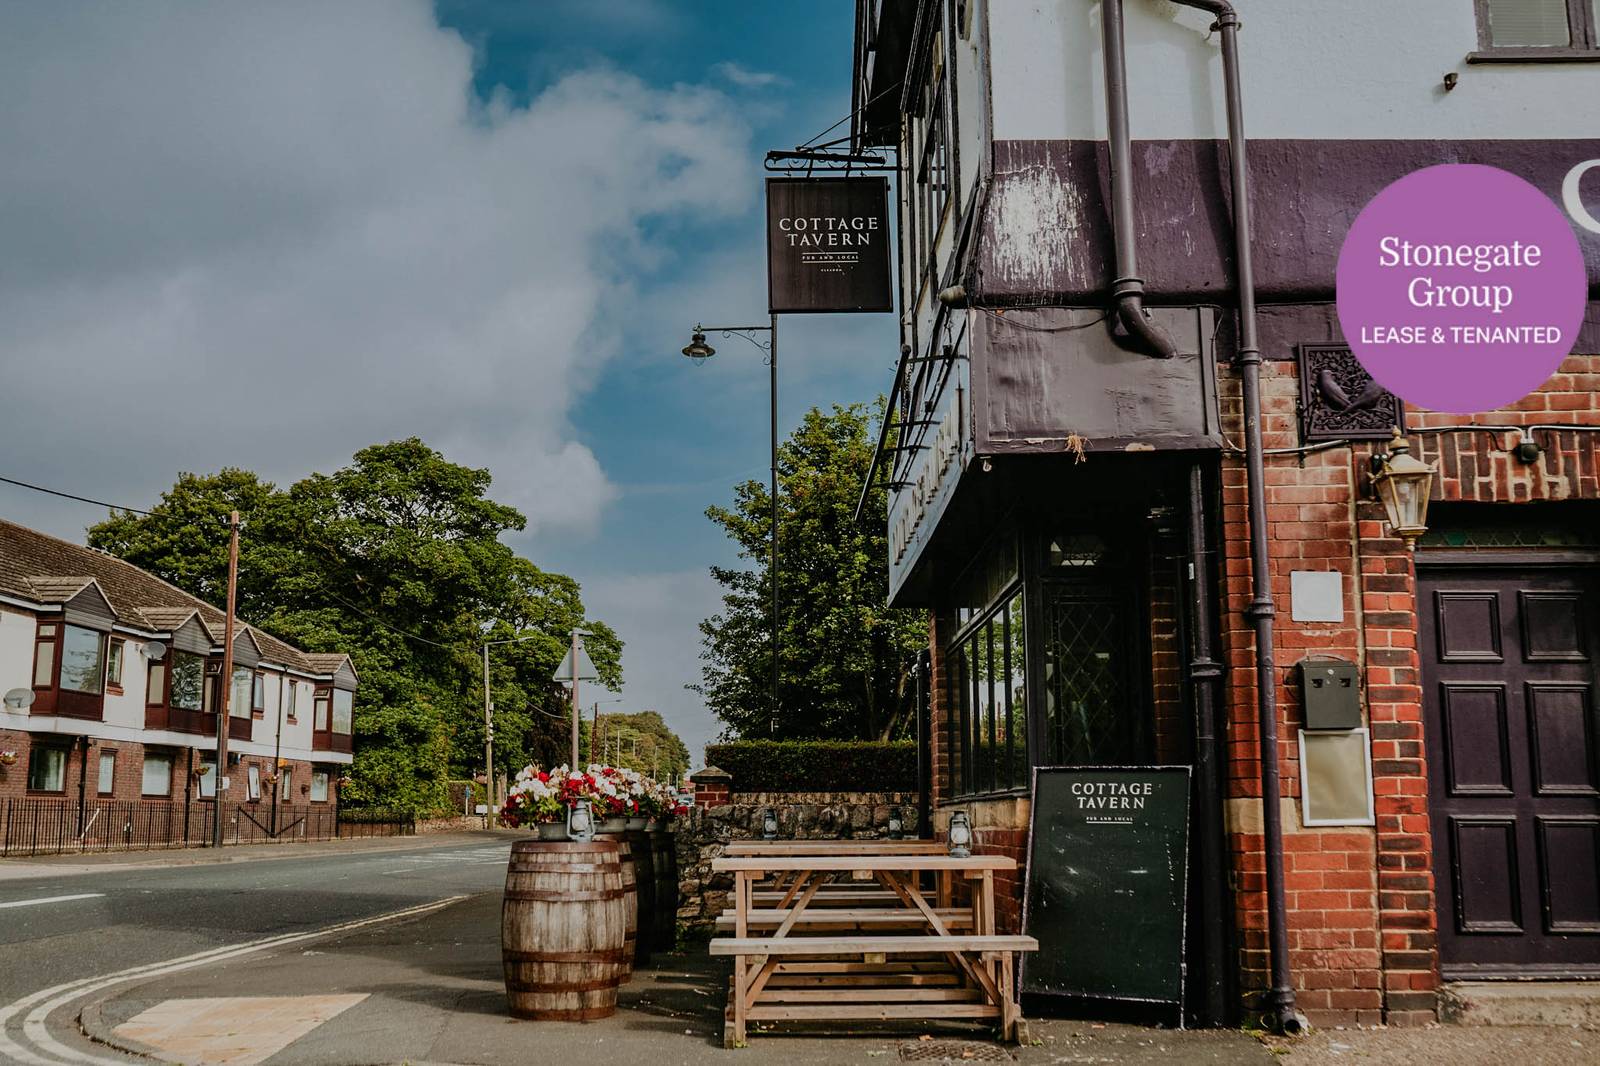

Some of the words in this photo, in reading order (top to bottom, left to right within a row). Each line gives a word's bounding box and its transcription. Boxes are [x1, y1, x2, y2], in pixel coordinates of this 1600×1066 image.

[779, 217, 878, 231] COTTAGE
[787, 233, 870, 246] TAVERN
[1071, 782, 1152, 795] COTTAGE
[1077, 797, 1145, 809] TAVERN
